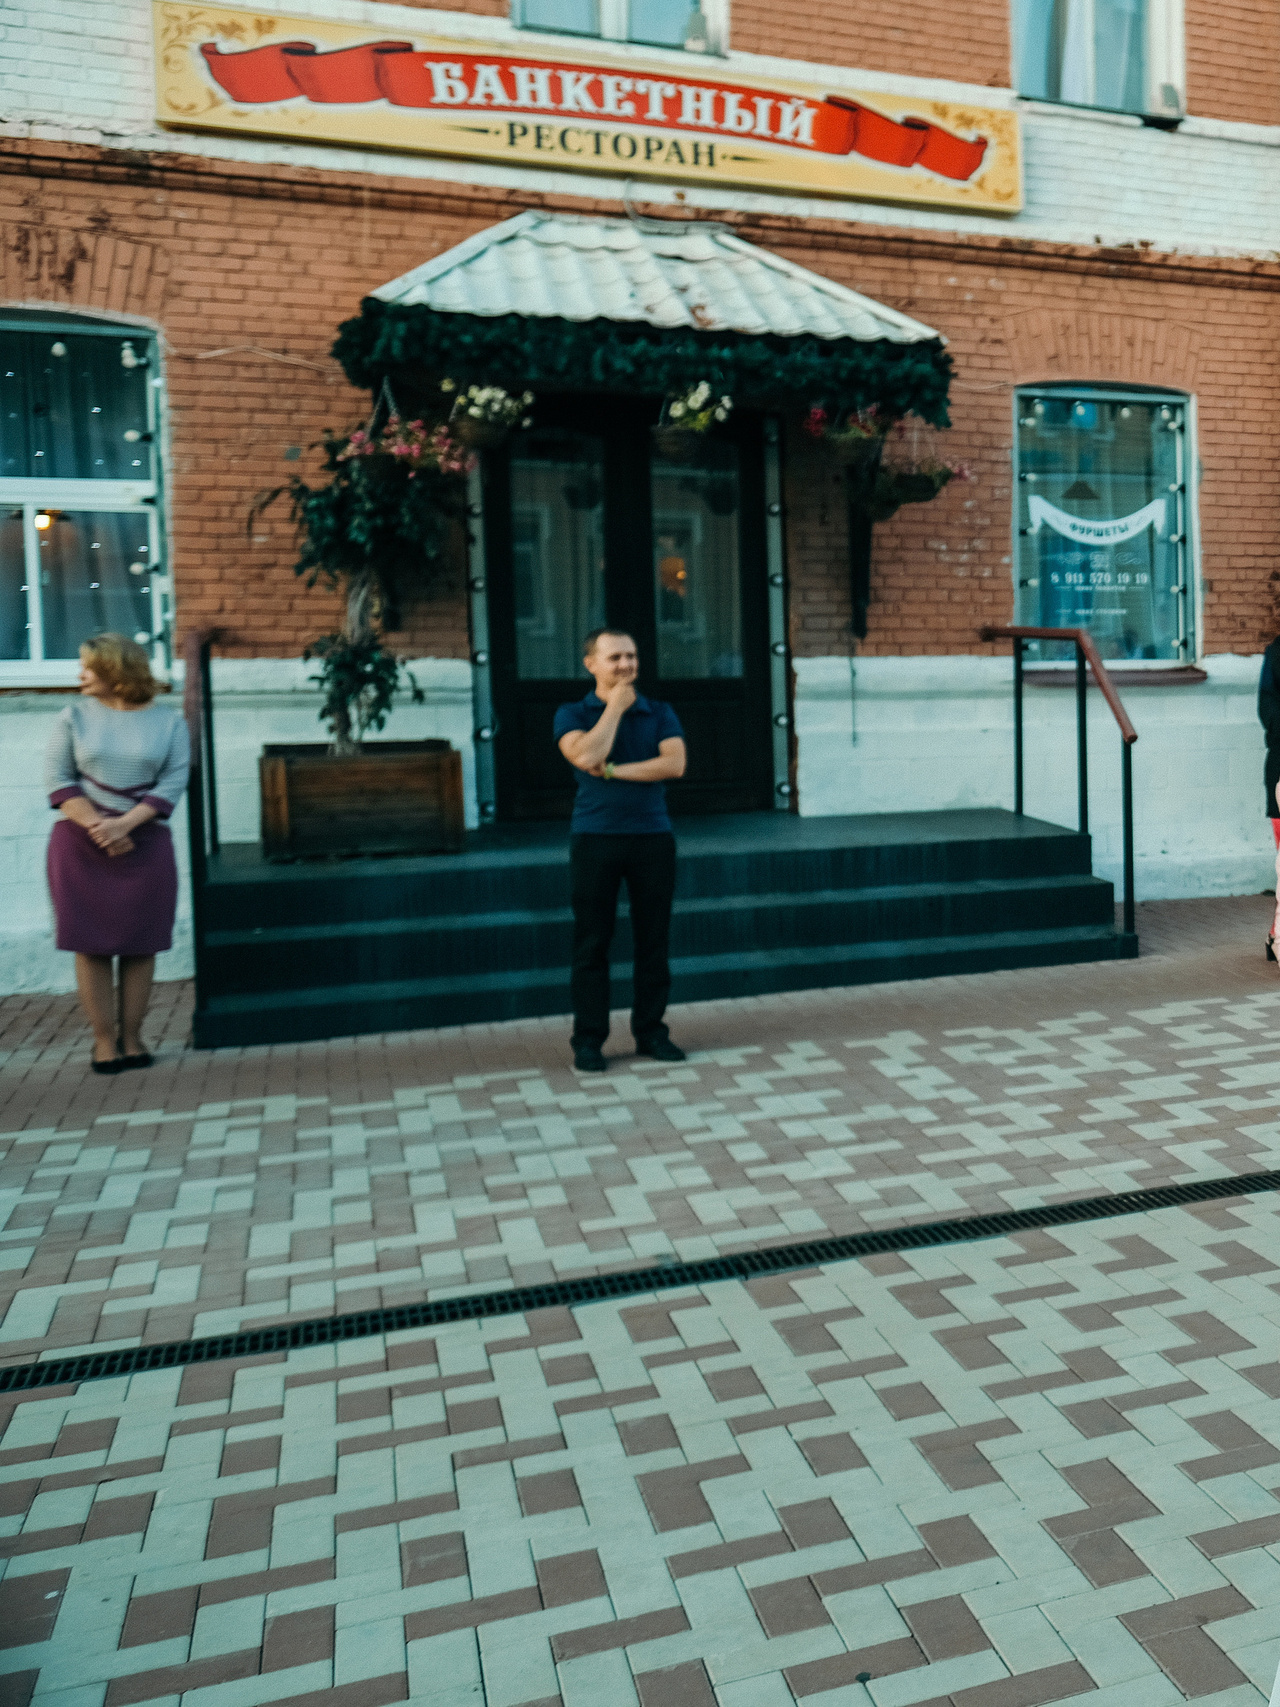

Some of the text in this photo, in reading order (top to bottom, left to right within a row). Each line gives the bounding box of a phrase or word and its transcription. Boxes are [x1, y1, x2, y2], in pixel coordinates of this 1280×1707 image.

[424, 61, 818, 145] БАНКЕТНЫЙ
[507, 122, 716, 167] РЕСТОРАН
[1069, 523, 1129, 537] ФУРШЕТЫ
